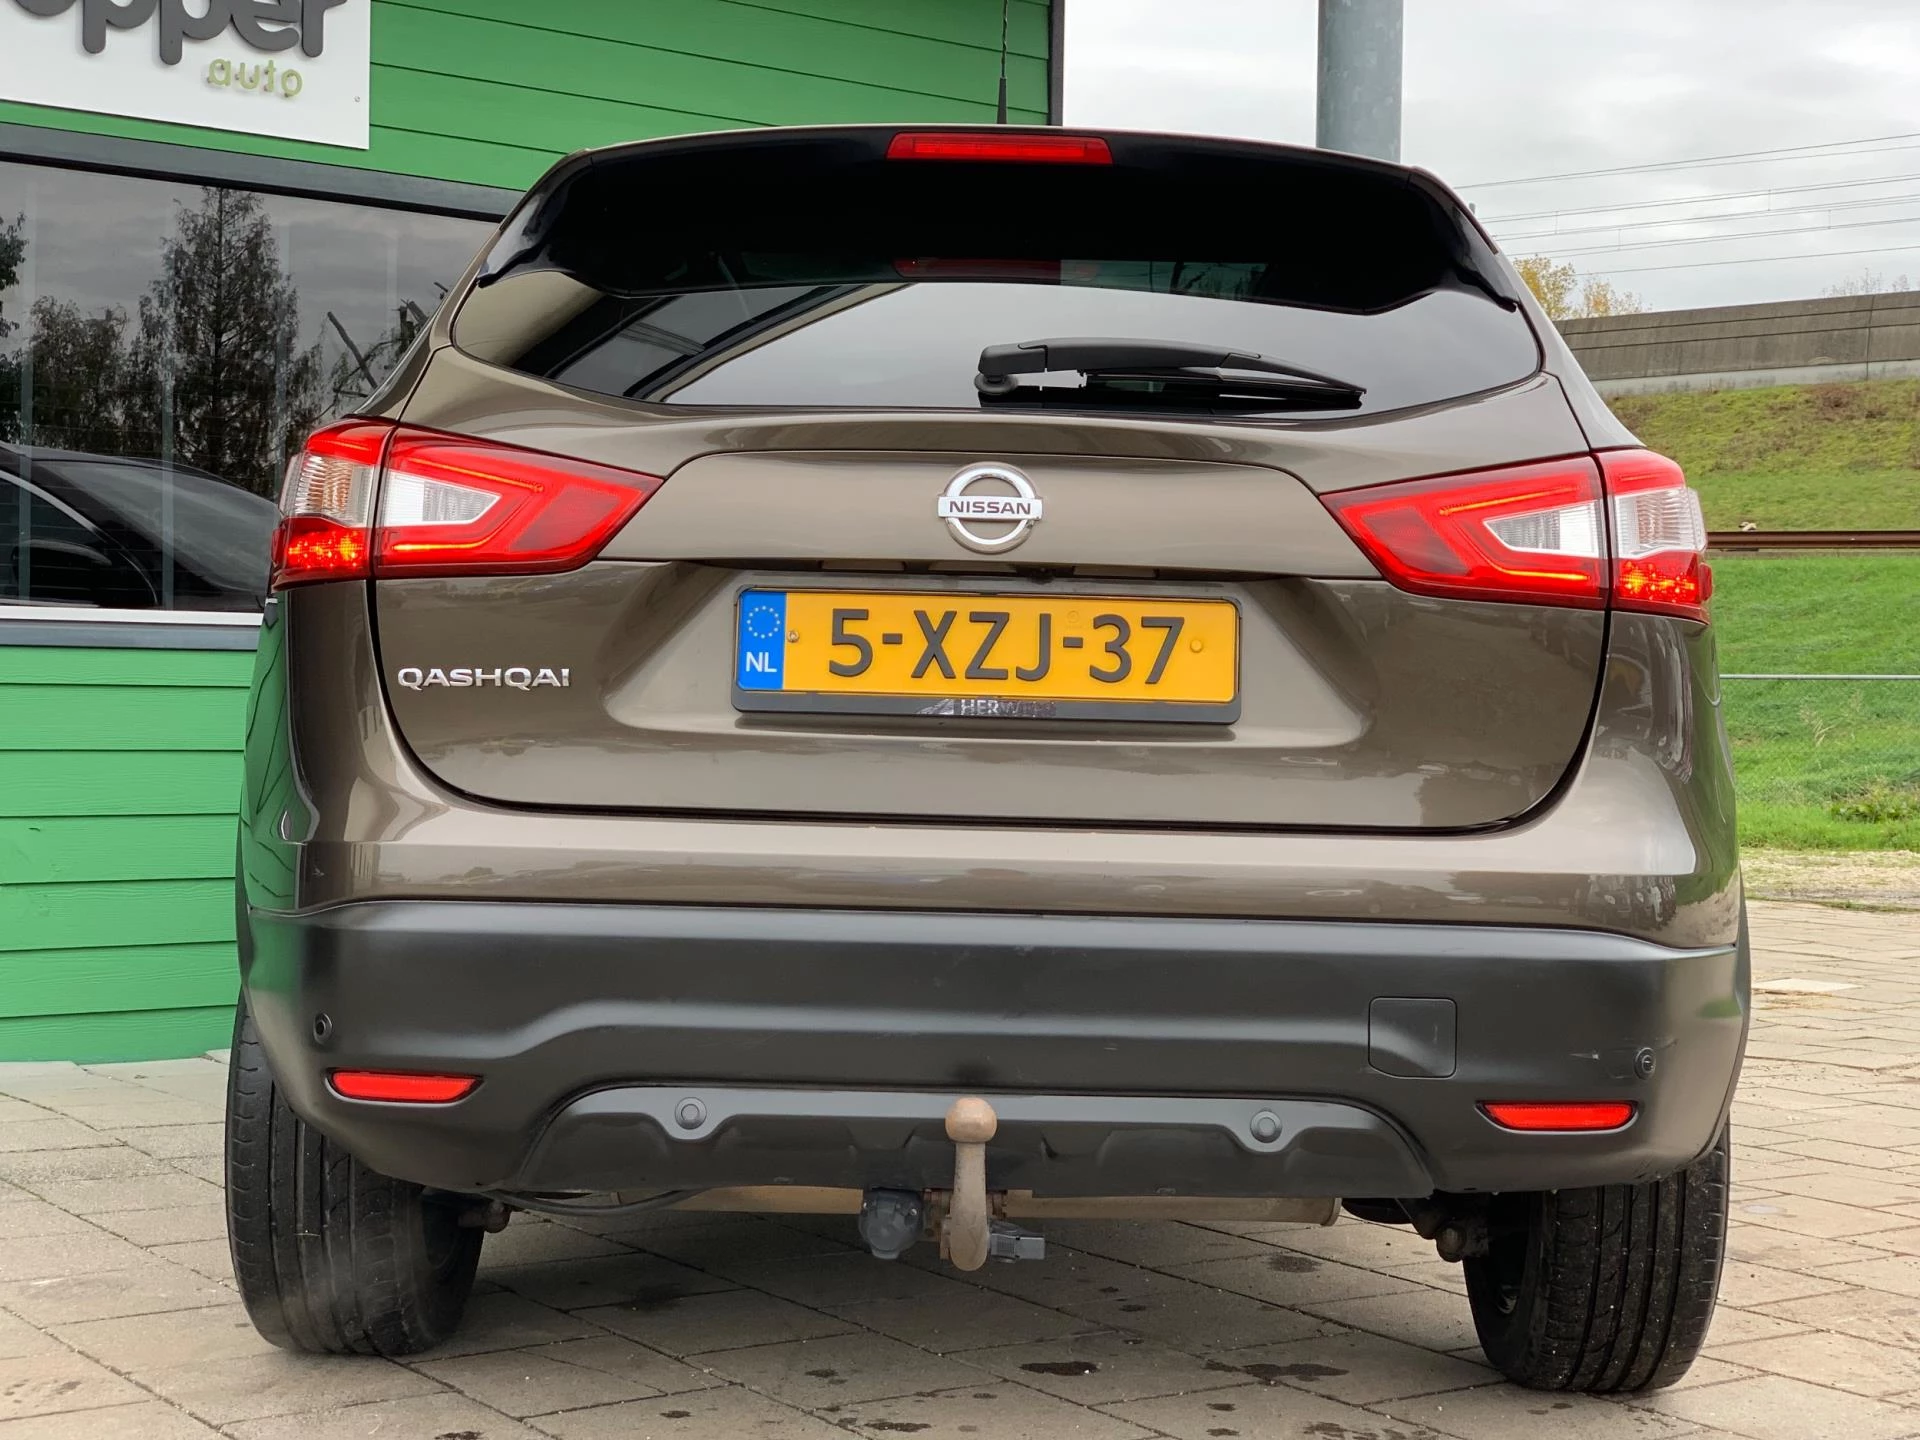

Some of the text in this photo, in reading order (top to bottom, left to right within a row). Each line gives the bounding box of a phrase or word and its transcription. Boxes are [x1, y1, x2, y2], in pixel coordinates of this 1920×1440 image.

[14, 0, 350, 65] pper
[207, 58, 304, 97] auto
[949, 500, 1032, 515] NISSAN
[828, 607, 1185, 685] 5-XZJ-37
[745, 651, 777, 674] NL
[397, 667, 570, 691] QASHQAI
